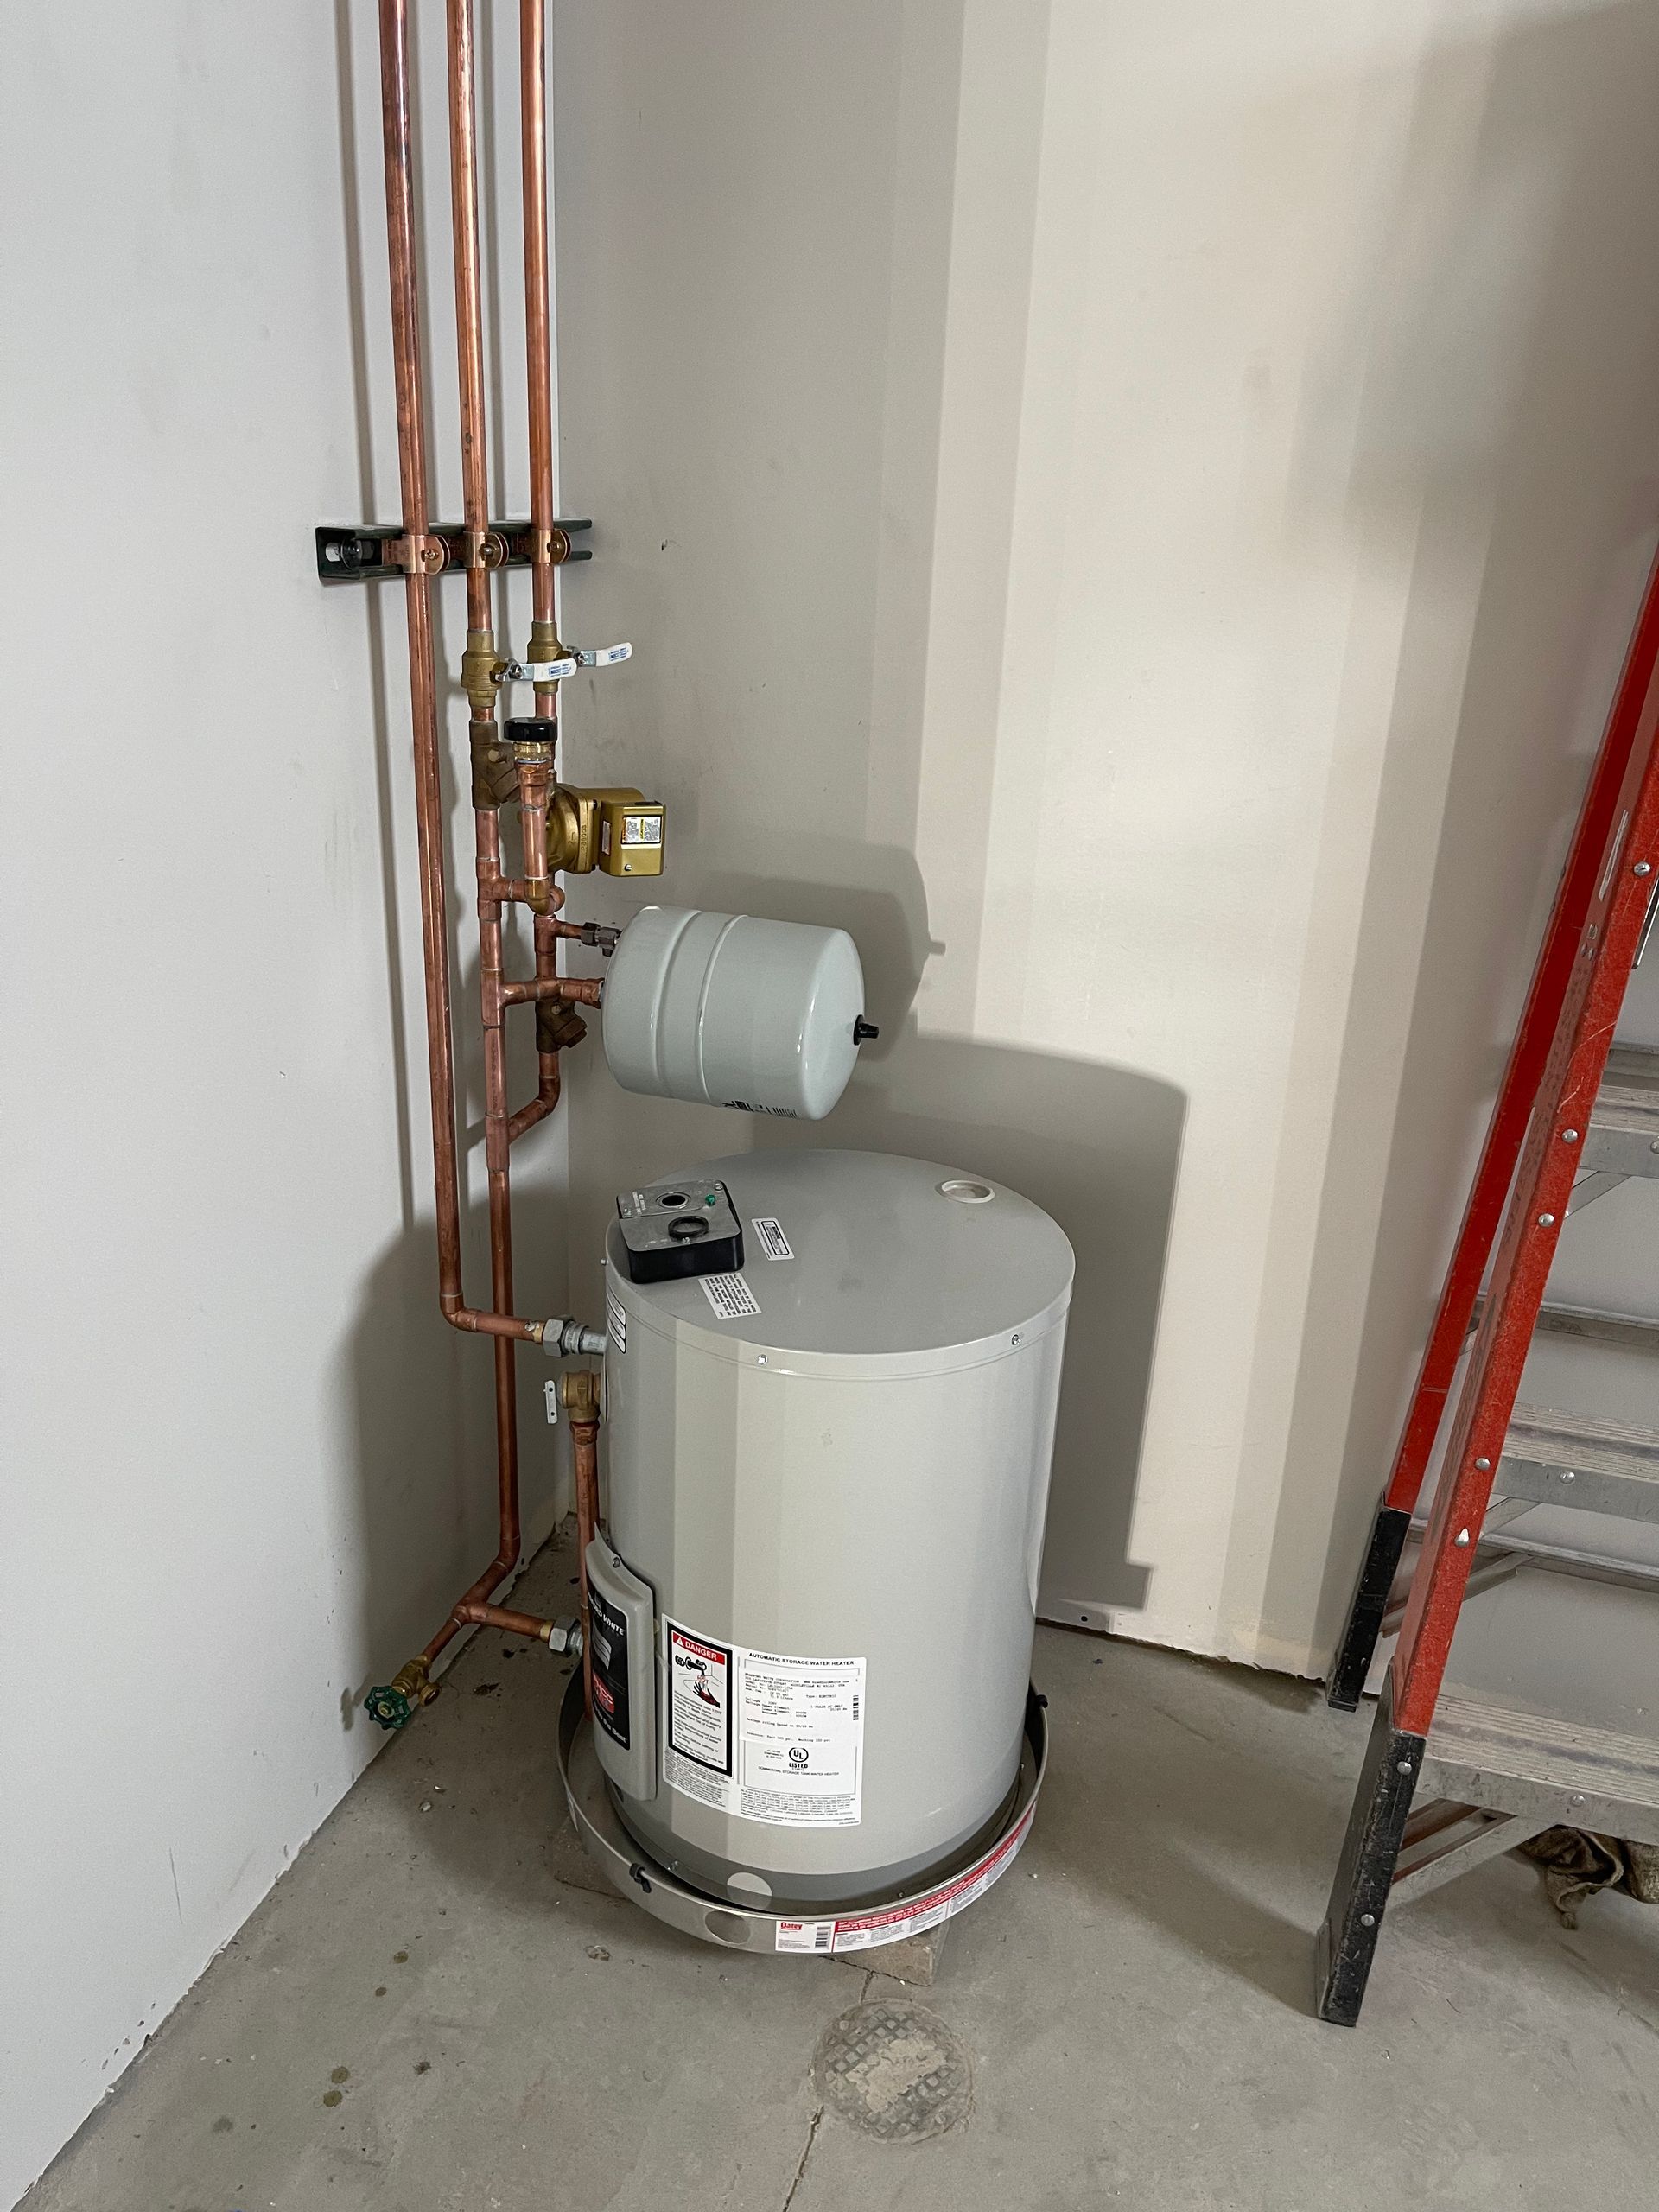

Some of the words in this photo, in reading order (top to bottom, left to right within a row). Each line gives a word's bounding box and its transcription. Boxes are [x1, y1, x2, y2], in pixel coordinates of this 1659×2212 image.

[603, 1614, 625, 1636] WHITE
[685, 1641, 717, 1661] DANGER
[748, 1652, 780, 1662] AUTOMATIC
[793, 1750, 804, 1760] UL
[781, 1922, 803, 1930] Oatey
